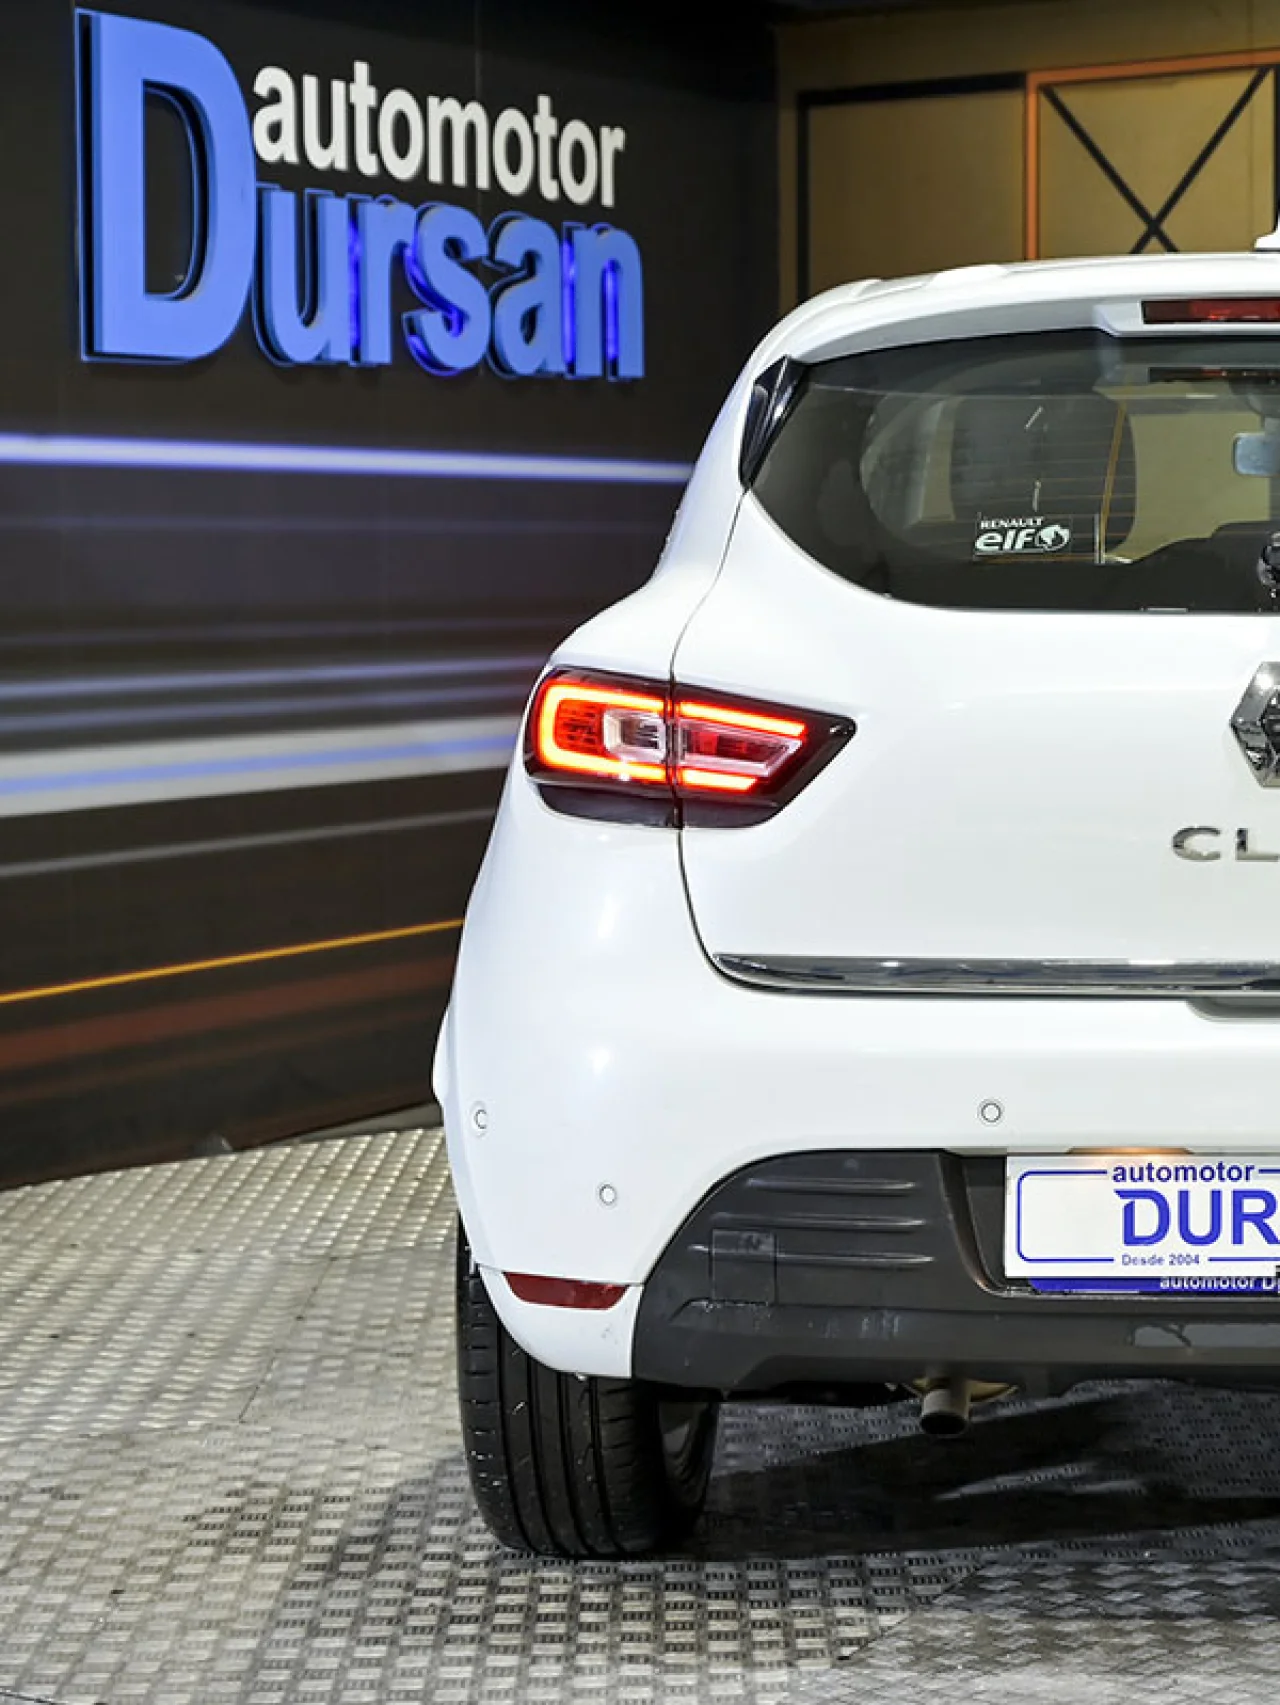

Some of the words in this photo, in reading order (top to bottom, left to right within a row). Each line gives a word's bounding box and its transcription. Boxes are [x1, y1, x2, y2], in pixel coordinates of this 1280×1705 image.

[253, 61, 626, 207] automotor
[75, 8, 645, 381] Dursan
[980, 516, 1043, 529] RENAULT
[1112, 1161, 1255, 1183] automotor
[1121, 1253, 1165, 1266] Desde
[1168, 1253, 1200, 1266] 2004
